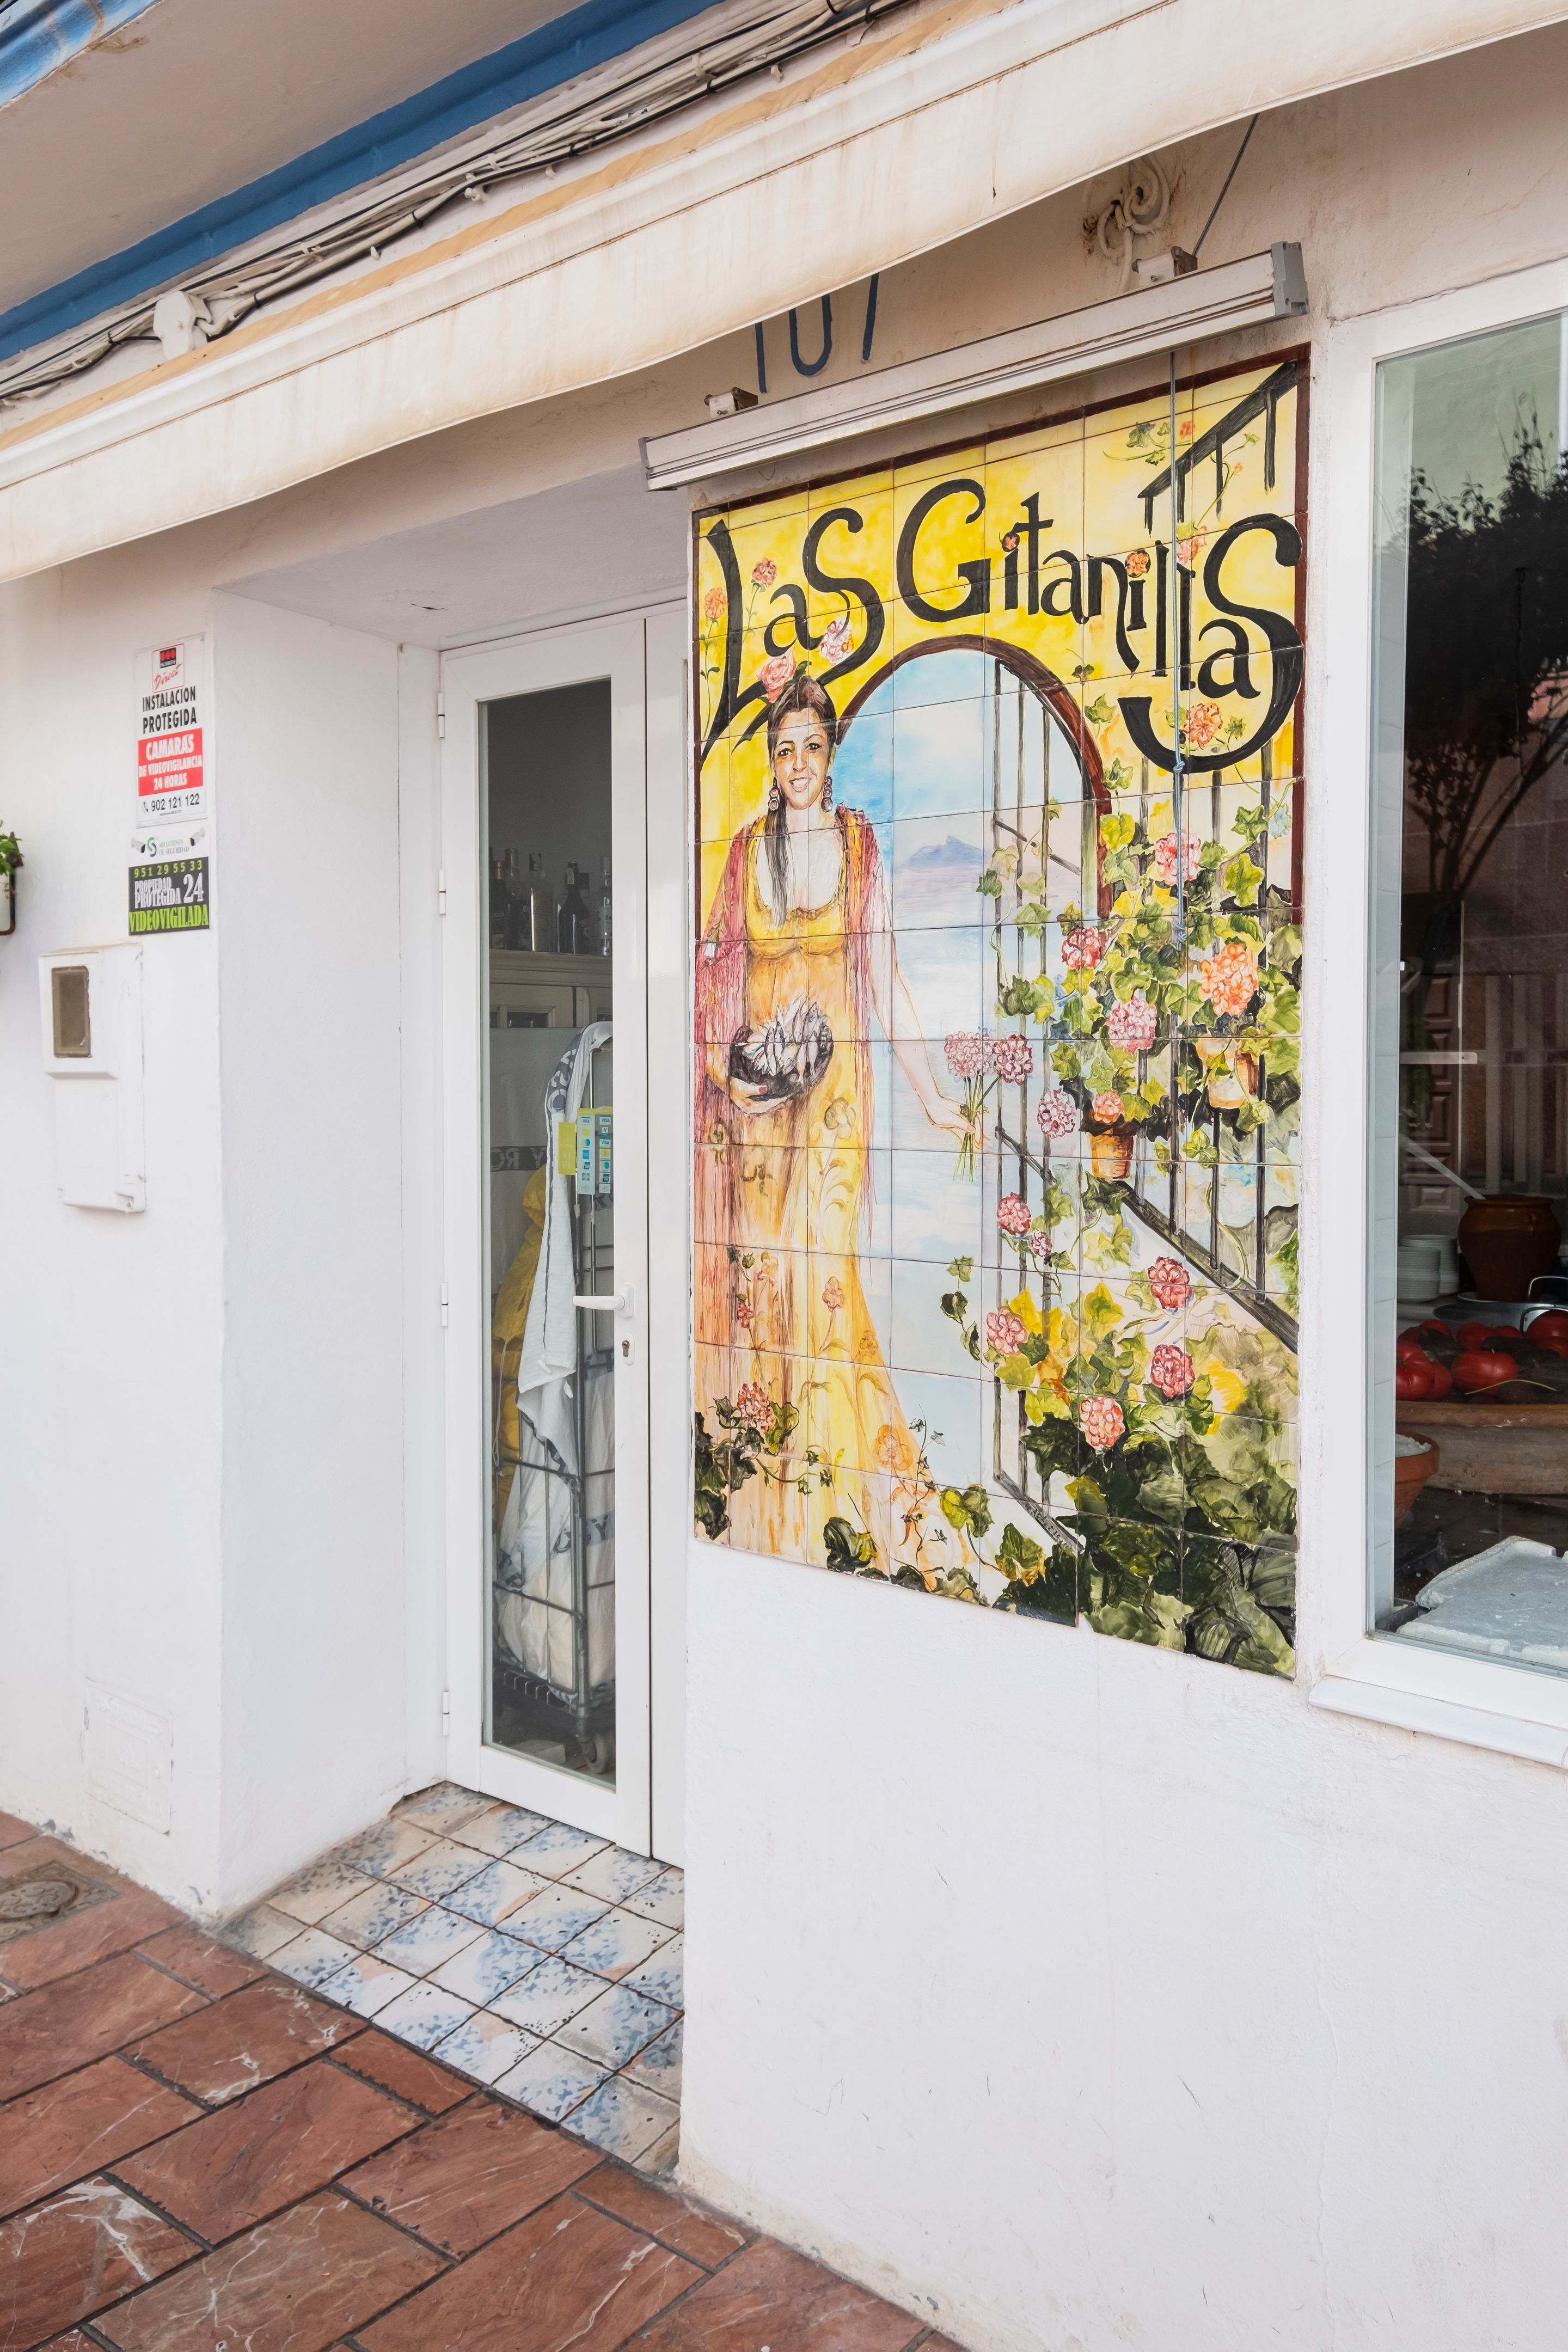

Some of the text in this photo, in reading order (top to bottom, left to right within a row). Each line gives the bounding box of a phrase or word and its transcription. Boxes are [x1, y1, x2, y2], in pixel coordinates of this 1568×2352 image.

[154, 663, 182, 690] Direct
[143, 686, 196, 712] INSTALACION
[143, 707, 197, 734] PROTEGIDA
[145, 734, 194, 761] CAMARAS
[138, 755, 203, 777] DE VIDEOVIGILANCIA
[153, 773, 187, 791] 24 HORAS
[151, 793, 199, 812] 902 121 122
[158, 839, 183, 848] SOLUCIONES
[166, 846, 189, 855] SEGURIDAD
[134, 860, 203, 878] 951 29 55 33
[134, 877, 172, 894] PROPIEDAD
[183, 872, 204, 903] 24
[134, 888, 182, 909] PROTEGIDA
[128, 904, 209, 932] VIDEOVIGILADA
